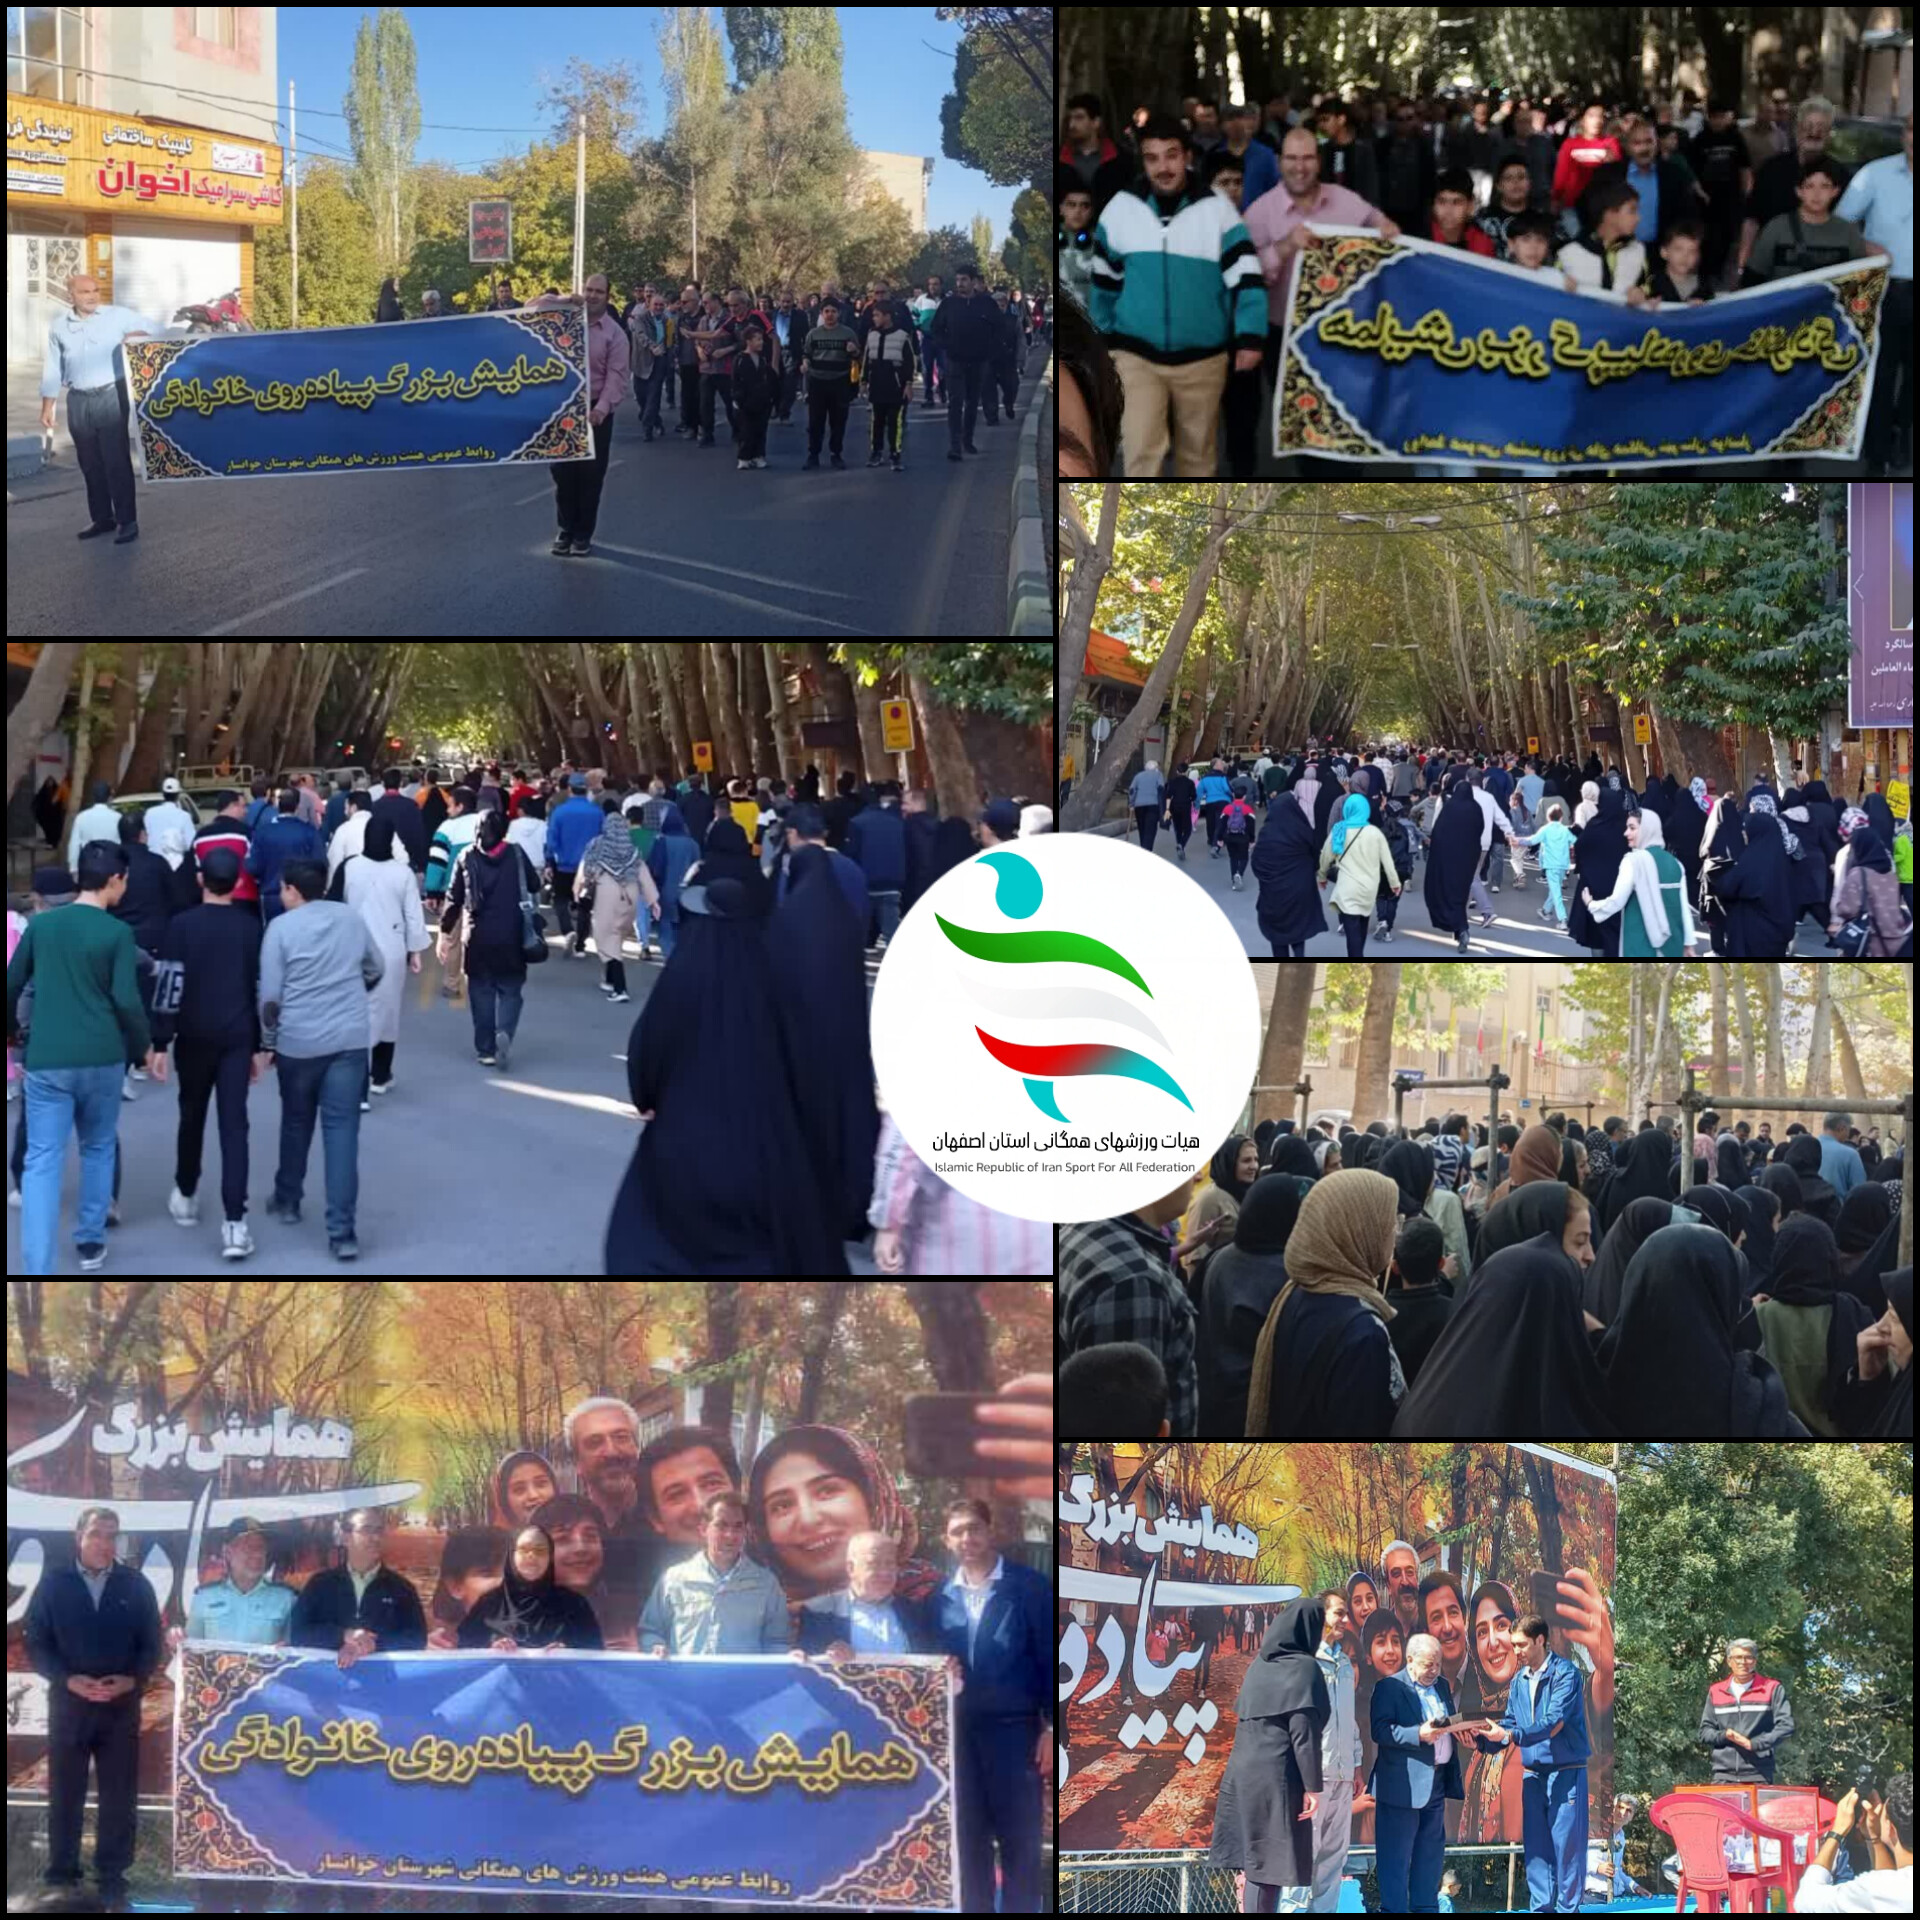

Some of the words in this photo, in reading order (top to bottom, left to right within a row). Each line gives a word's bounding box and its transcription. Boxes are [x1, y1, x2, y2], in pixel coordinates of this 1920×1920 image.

[103, 126, 154, 146] ساختمانی
[157, 135, 193, 155] کلینیک
[98, 157, 191, 200] اخوان
[374, 362, 454, 402] بزرگ
[453, 354, 567, 398] همایش
[150, 376, 255, 417] خانوادگی
[264, 457, 304, 470] شهرستان
[344, 454, 364, 467] های
[427, 449, 462, 462] عمومی
[465, 446, 496, 459] روابط
[227, 459, 261, 473] خوانسار
[1871, 662, 1902, 676] العاملین
[92, 1402, 187, 1470] بزرگ
[186, 1407, 353, 1471] همایش
[1059, 1474, 1137, 1545] بزرگ
[1135, 1501, 1259, 1559] همایش
[199, 1713, 390, 1777] خانوادگی
[592, 1725, 727, 1790] بزرگ
[724, 1730, 918, 1792] همایش
[316, 1853, 379, 1876] خوانسار
[382, 1856, 455, 1879] شهرستان
[459, 1859, 522, 1880] همگانی
[525, 1863, 560, 1883] های
[564, 1865, 619, 1887] ورزش
[671, 1872, 734, 1892] عمومی
[739, 1869, 791, 1895] روابط
